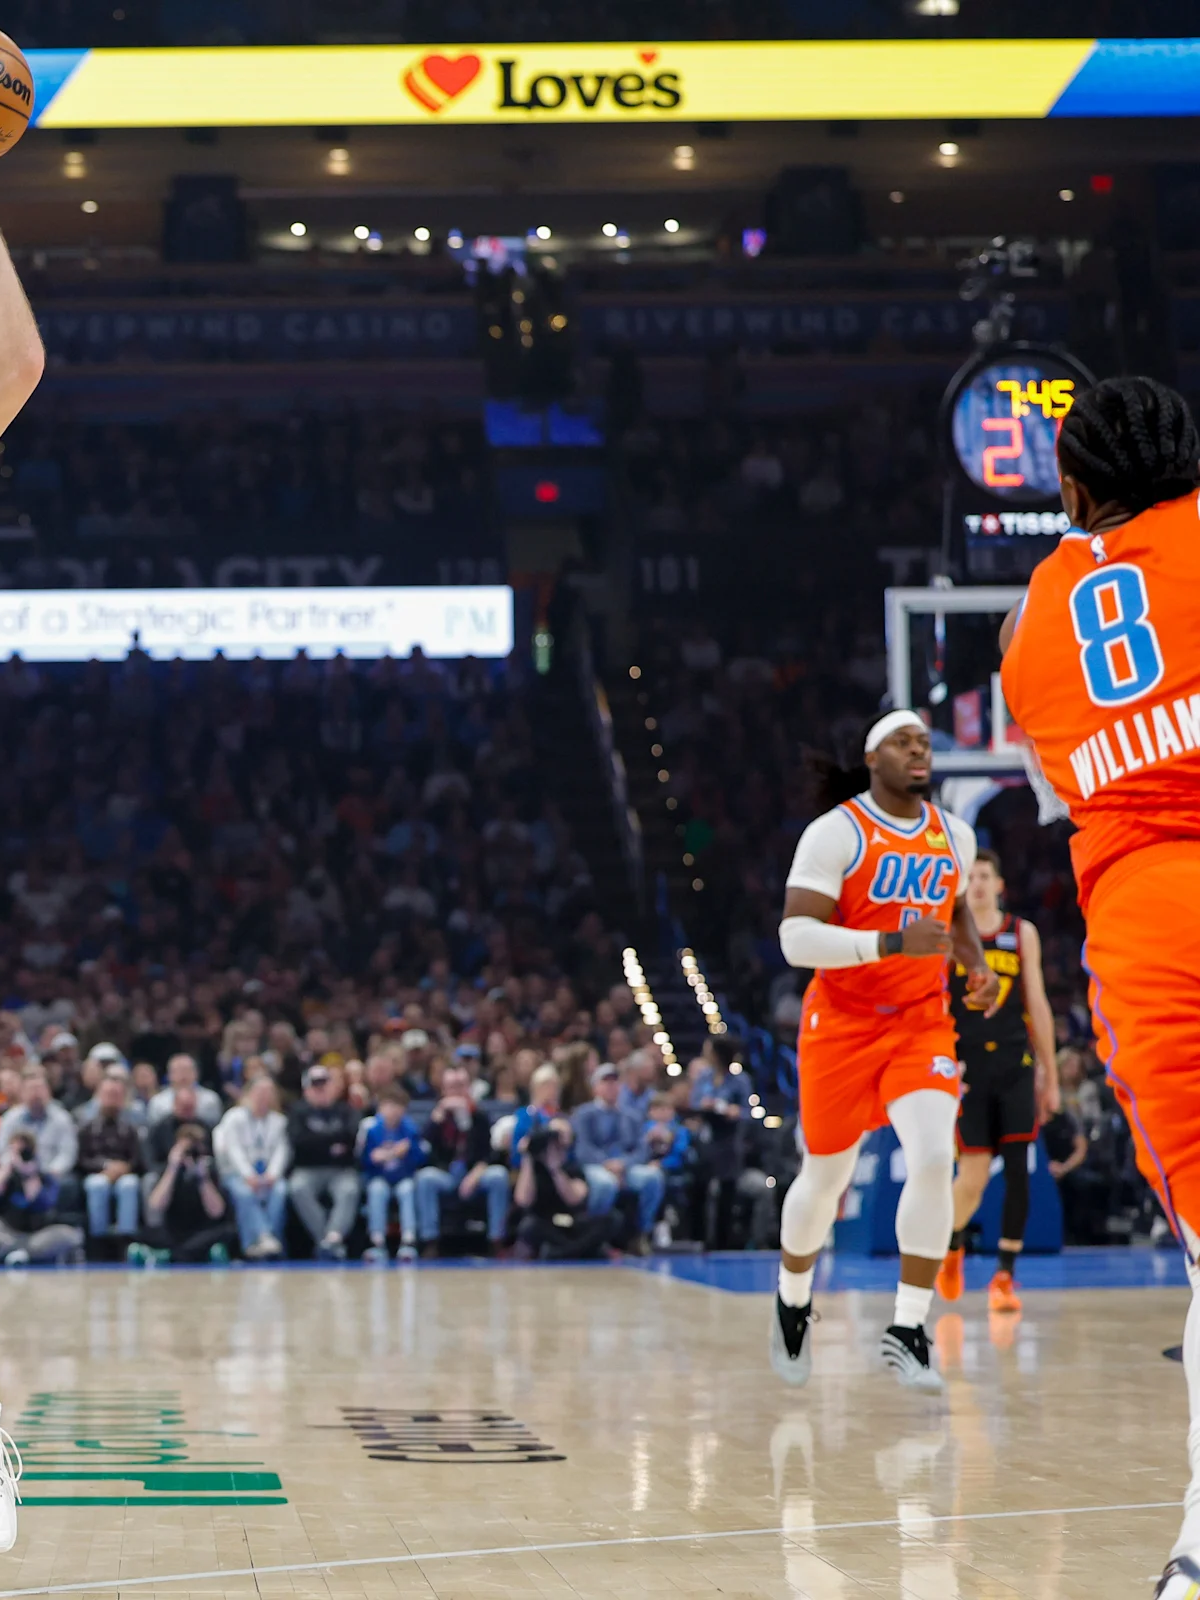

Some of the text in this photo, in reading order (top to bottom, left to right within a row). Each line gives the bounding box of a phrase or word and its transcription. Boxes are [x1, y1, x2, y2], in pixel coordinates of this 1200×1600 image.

[995, 379, 1076, 420] 7:45
[79, 600, 236, 644] Strategic
[1068, 562, 1165, 708] 8
[868, 851, 955, 906] OKC
